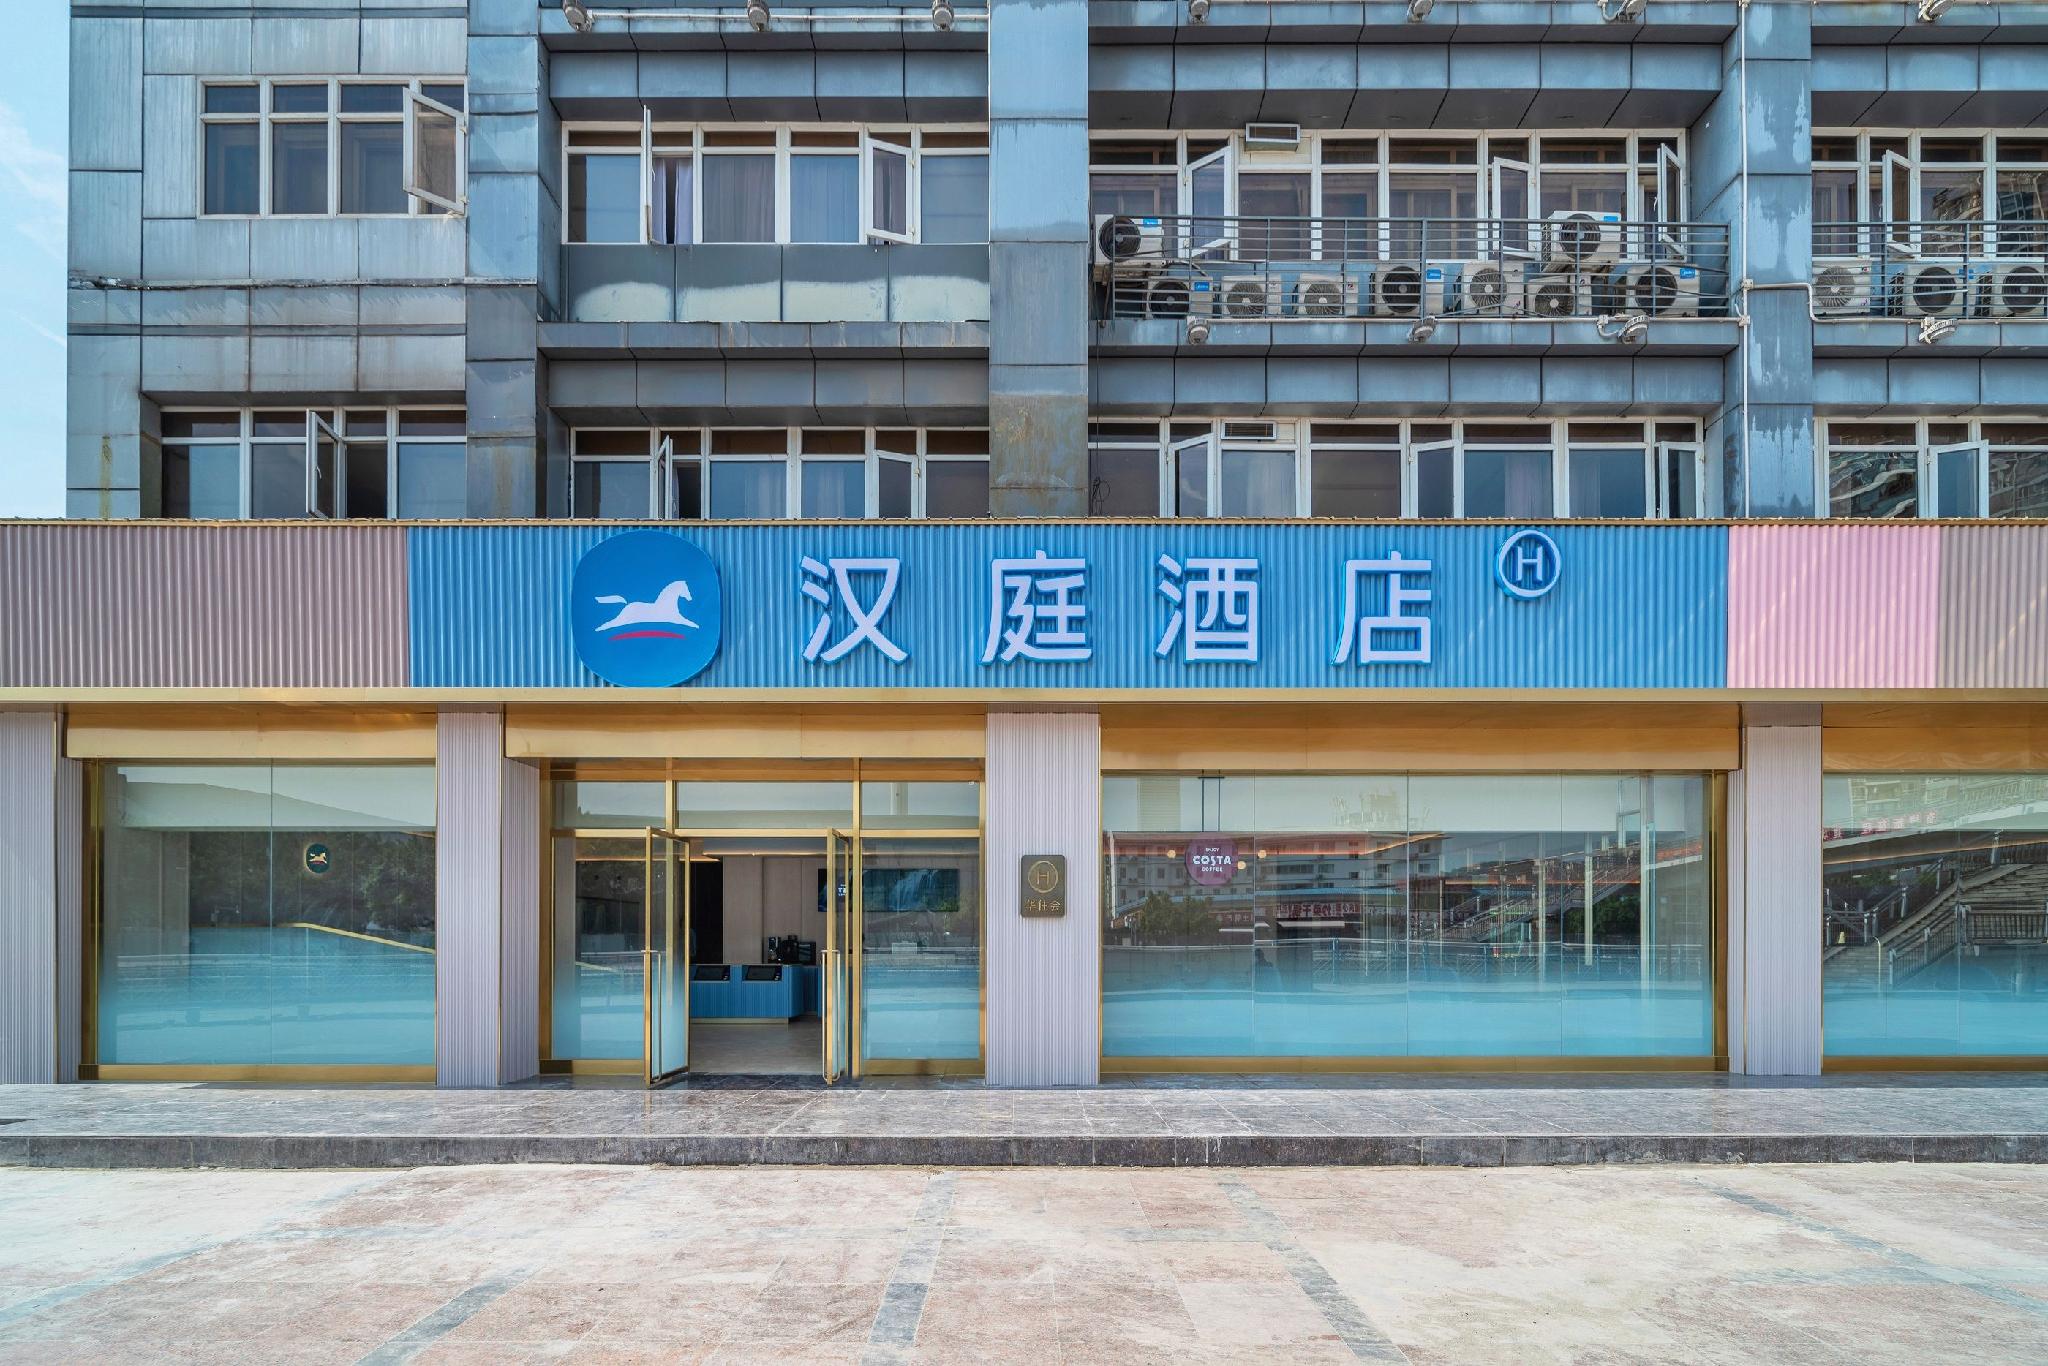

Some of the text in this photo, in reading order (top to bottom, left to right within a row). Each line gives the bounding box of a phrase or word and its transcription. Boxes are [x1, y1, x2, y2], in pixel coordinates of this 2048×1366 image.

[799, 547, 1433, 667] 汉庭酒店
[1192, 855, 1232, 866] COSTA
